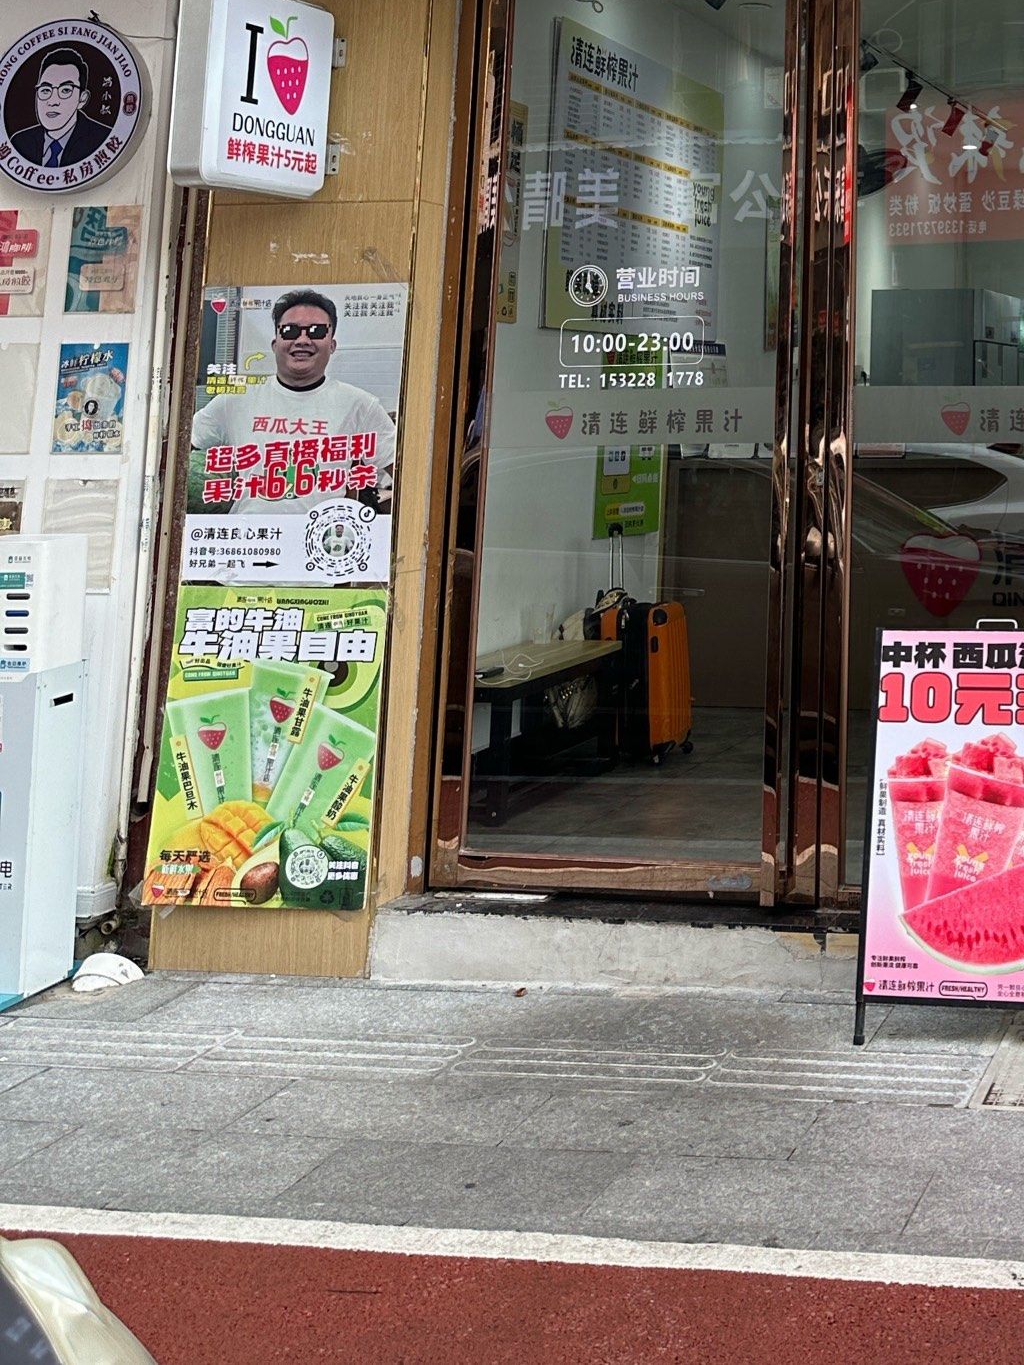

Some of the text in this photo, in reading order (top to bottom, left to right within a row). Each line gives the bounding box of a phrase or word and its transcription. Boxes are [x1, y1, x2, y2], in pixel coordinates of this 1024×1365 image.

[18, 28, 56, 56] COFFEE
[57, 26, 68, 36] SI
[71, 26, 98, 41] FANG
[96, 34, 120, 55] JIAN
[114, 53, 132, 78] JIAO
[240, 22, 264, 105] I
[571, 36, 639, 92] 清连鲜榨果汁
[232, 112, 315, 147] DONGGUAN
[226, 137, 317, 176] 鲜榨果汁5元起
[616, 266, 700, 290] 营业时间
[618, 291, 704, 302] BUSINESS HOURS
[572, 332, 694, 353] 10:00-23:00
[207, 363, 237, 375] 关注
[559, 371, 704, 388] TEL: 153228 1778
[252, 416, 329, 436] 西瓜大王
[581, 408, 743, 435] 清连鲜榨果汁
[205, 432, 378, 473] 超多直播福利
[190, 526, 283, 542] @清连良心果汁
[189, 558, 246, 570] 好兄弟一起飞
[178, 629, 378, 663] 牛油果自由
[882, 641, 947, 670] 中杯
[290, 687, 313, 738] 牛油果甘露
[176, 751, 198, 812] 牛油果巴旦木
[325, 773, 358, 822] 牛油果酸奶
[159, 849, 211, 864] 每天严选
